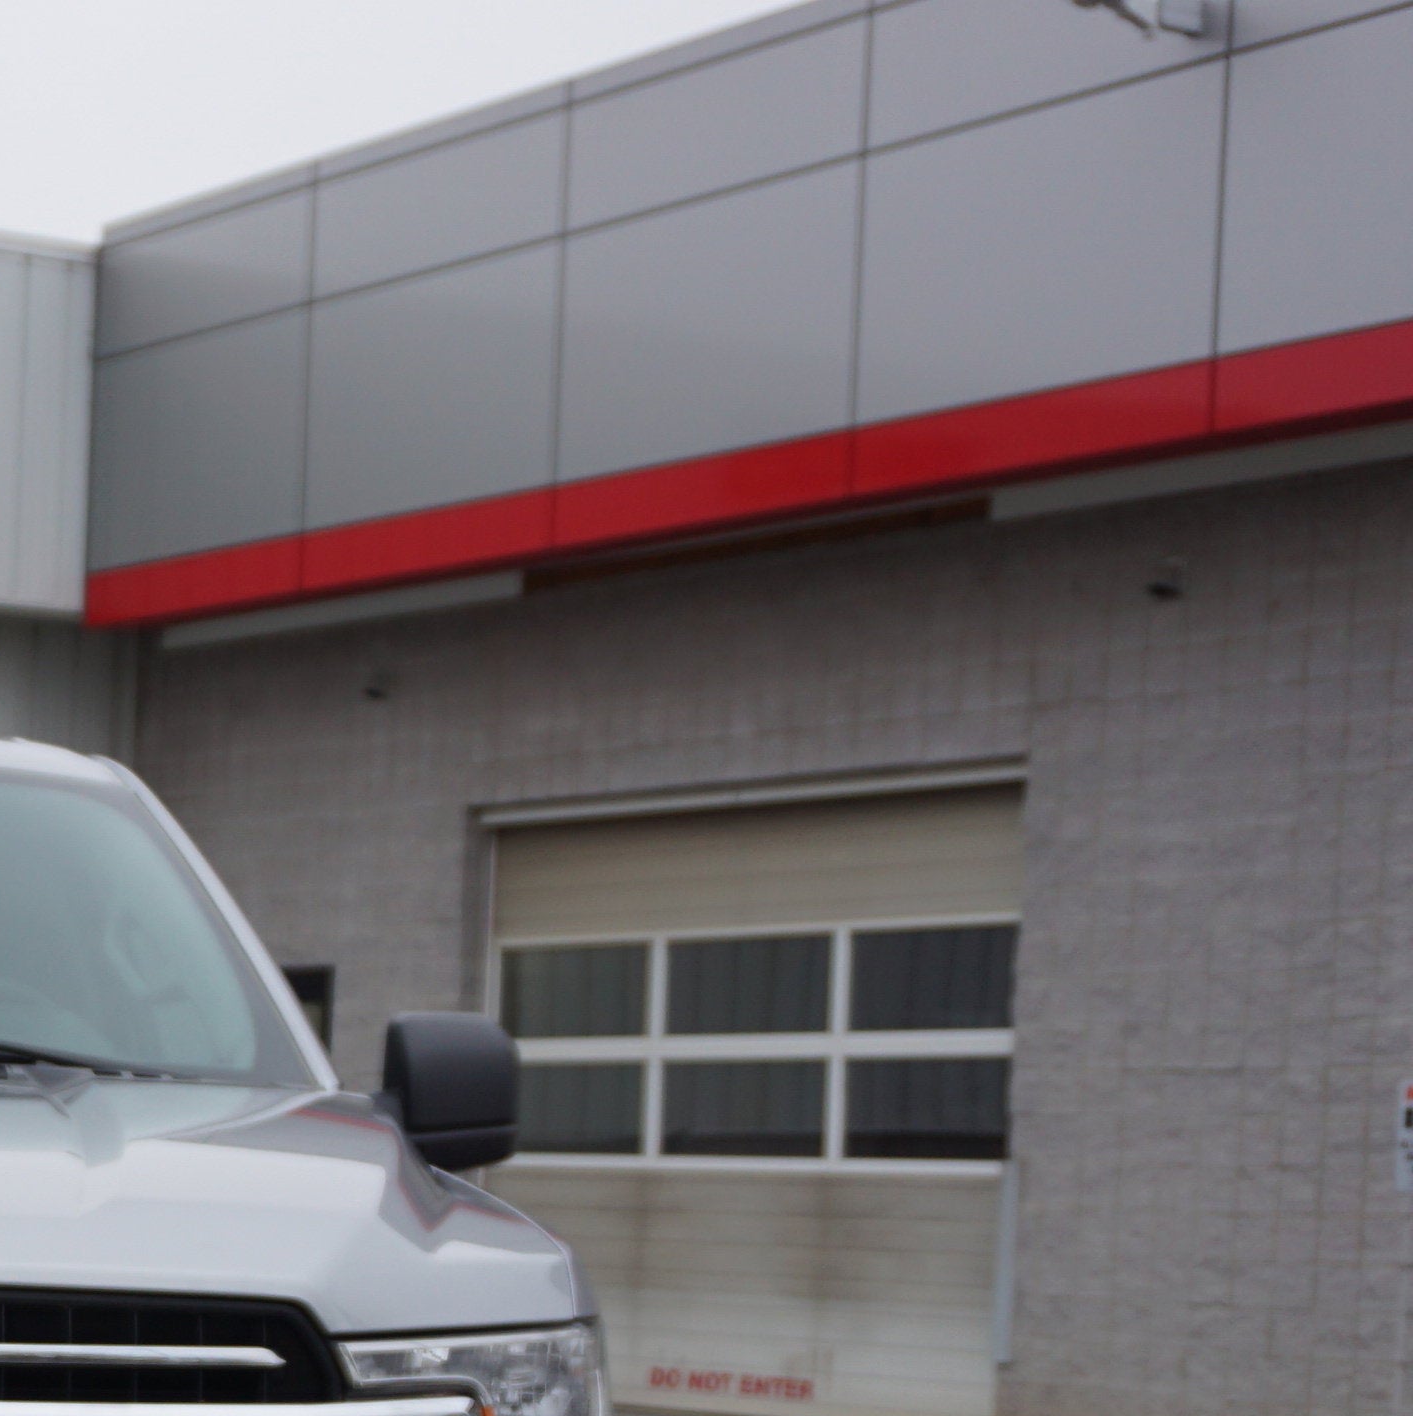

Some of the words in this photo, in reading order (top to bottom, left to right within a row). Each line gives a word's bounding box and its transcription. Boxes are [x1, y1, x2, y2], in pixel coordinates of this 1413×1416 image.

[649, 1367, 680, 1388] DO
[688, 1370, 732, 1393] NOT
[739, 1375, 814, 1399] ENTER
